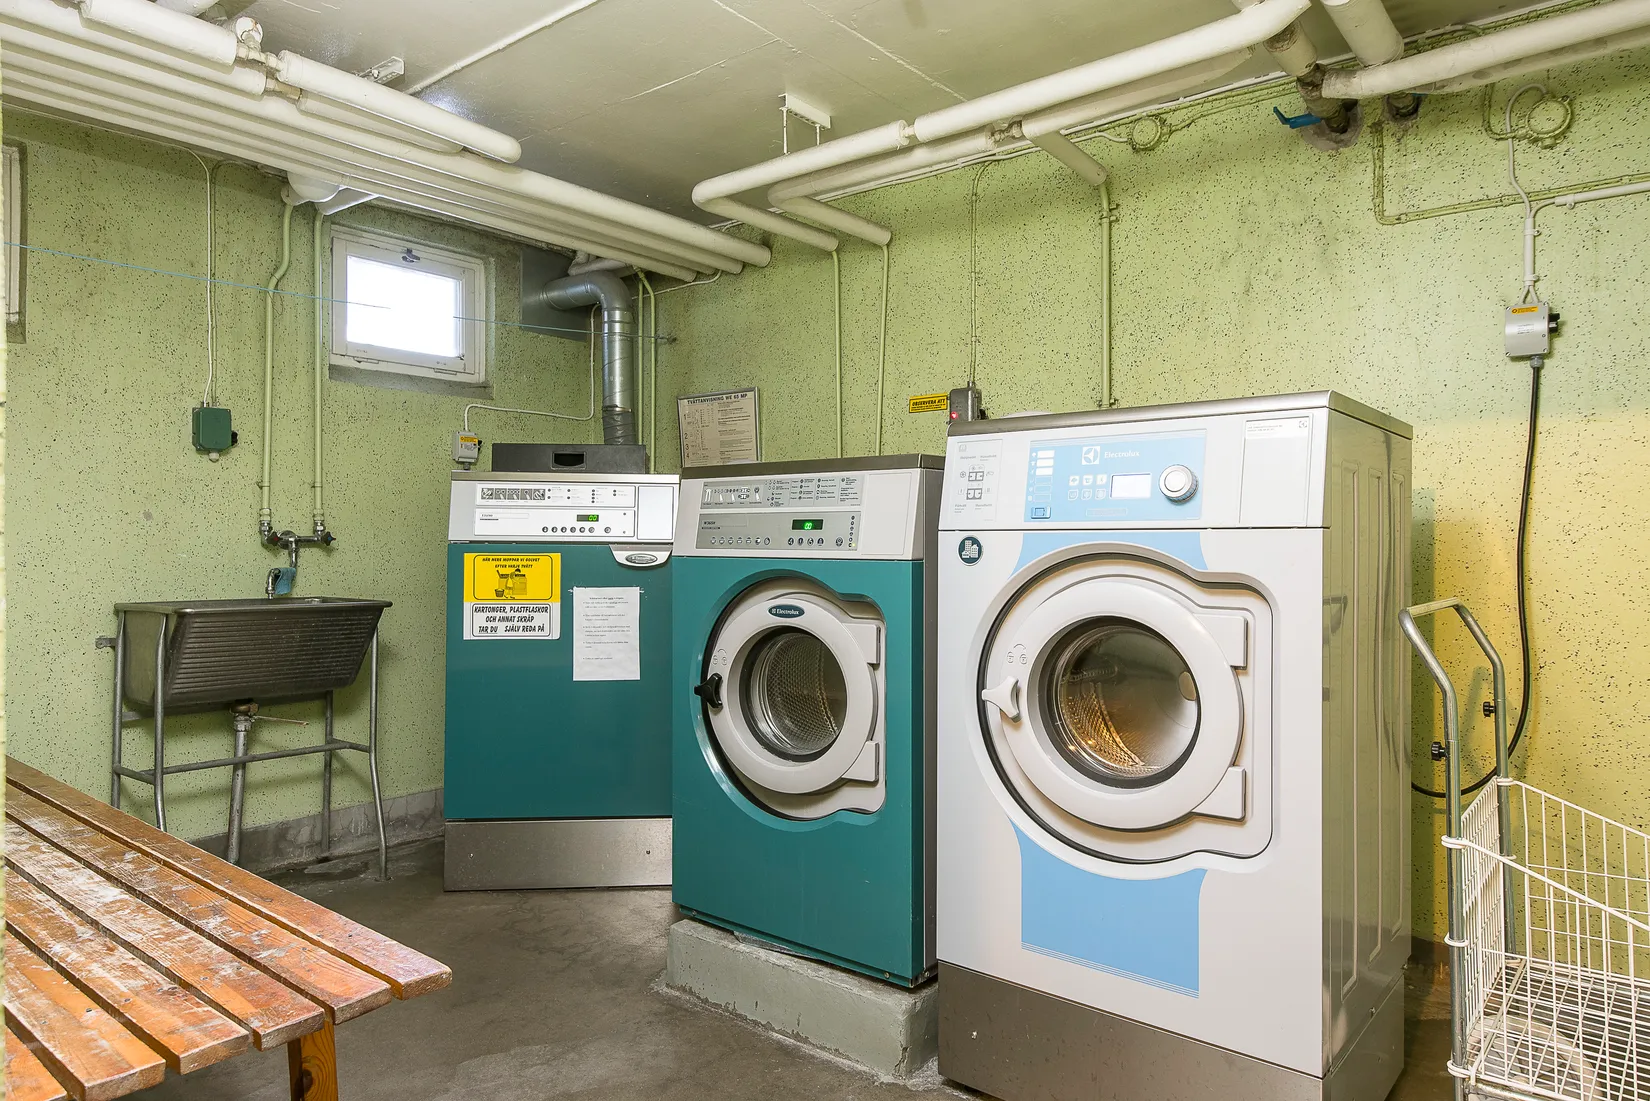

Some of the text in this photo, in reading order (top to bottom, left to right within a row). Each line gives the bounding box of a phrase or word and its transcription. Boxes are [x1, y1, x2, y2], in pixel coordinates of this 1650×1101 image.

[1104, 450, 1140, 458] Electrolux
[474, 606, 508, 614] KARTONGER,
[517, 614, 535, 623] SKRÄP
[504, 624, 521, 632] SJÄLV
[521, 625, 536, 633] REDA
[537, 624, 545, 633] PÅ
